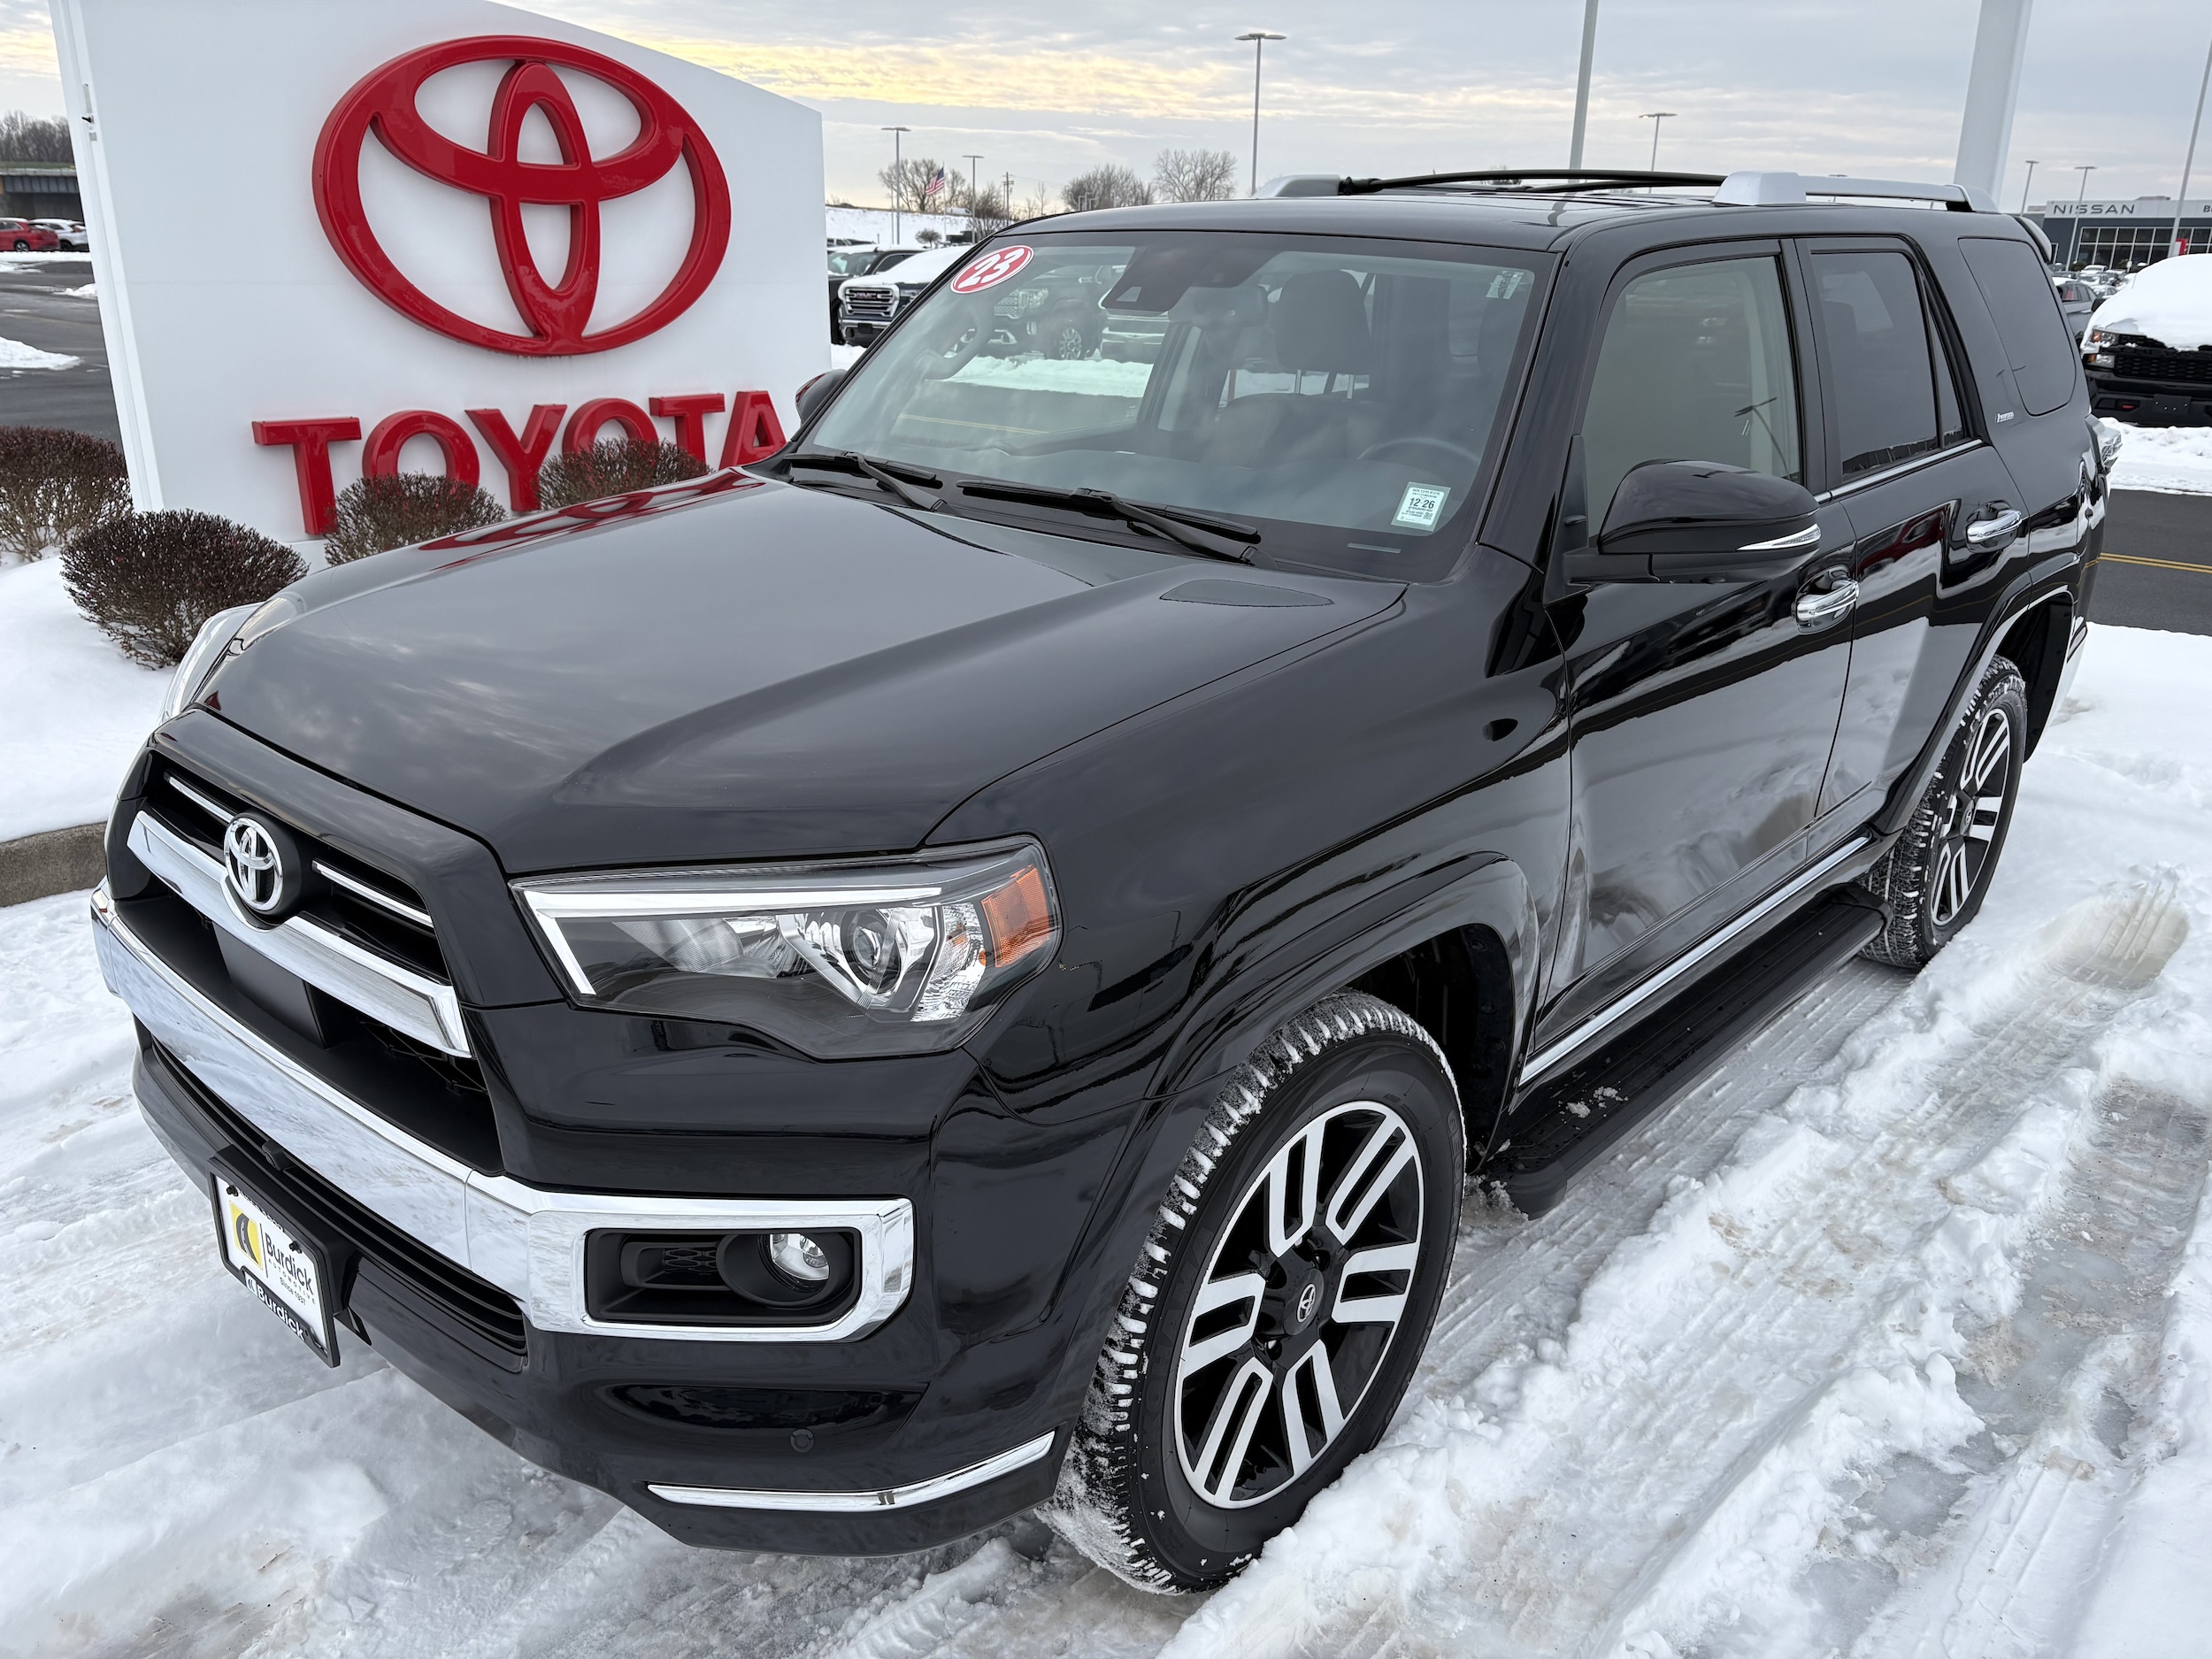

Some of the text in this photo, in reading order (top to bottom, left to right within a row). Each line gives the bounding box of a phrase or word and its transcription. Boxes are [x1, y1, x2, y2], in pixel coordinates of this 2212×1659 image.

[2053, 204, 2136, 215] NISSAN
[957, 248, 1025, 289] 23
[251, 390, 789, 535] TOYOTA
[265, 1233, 314, 1296] Burdick
[257, 1285, 305, 1341] Burdick
